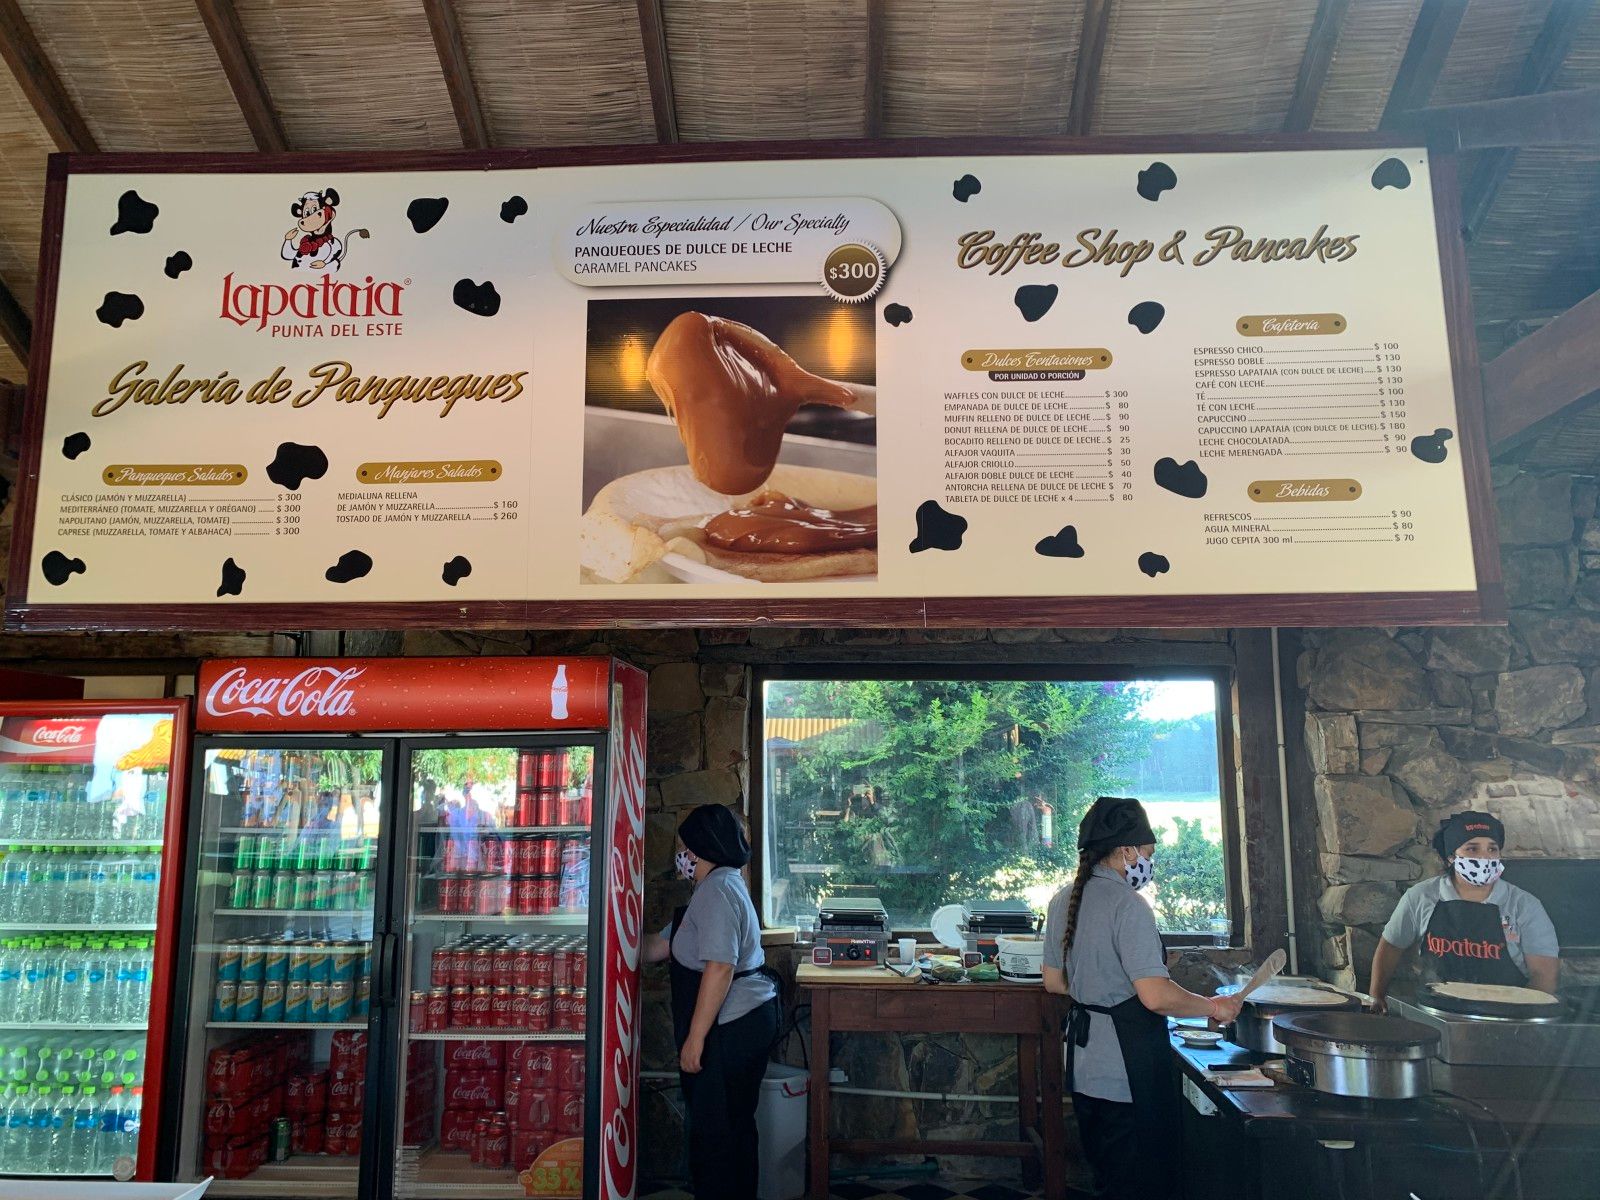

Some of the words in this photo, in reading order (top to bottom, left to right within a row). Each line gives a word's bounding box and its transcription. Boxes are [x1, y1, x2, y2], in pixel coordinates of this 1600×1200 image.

[577, 216, 639, 237] Nuestra
[642, 214, 731, 239] Especialidad
[733, 215, 744, 232] /
[751, 213, 784, 232] Our
[784, 212, 850, 236] Specialty
[575, 244, 661, 258] PANQUEQUES
[665, 243, 682, 255] DE
[686, 242, 727, 255] DULCE
[731, 242, 748, 254] DE
[752, 241, 792, 253] LECHE
[957, 230, 1060, 276] Coffee
[1061, 228, 1155, 278] Shop
[1158, 230, 1187, 264] &
[1193, 224, 1360, 267] Pancakes
[574, 262, 631, 274] CARAMEL
[634, 260, 697, 272] PANCAKES
[829, 262, 877, 280] $300
[1262, 317, 1320, 333] Cafetería
[272, 325, 324, 338] PUNTA
[331, 324, 360, 337] DEL
[366, 323, 403, 336] ESTE
[1193, 347, 1234, 355] ESPRESSO
[982, 353, 1021, 368] Dulces
[1026, 352, 1093, 368] Tentaciones
[1194, 358, 1234, 366] ESPRESSO
[1195, 381, 1215, 389] CAFÉ
[1239, 380, 1265, 388] LECHE
[91, 360, 243, 418] Galería
[245, 366, 292, 404] de
[292, 360, 529, 419] Panqueques
[944, 392, 978, 400] WAFFLES
[1028, 391, 1038, 399] DE
[944, 403, 988, 411] EMPANADA
[1196, 403, 1205, 411] TÉ
[1208, 403, 1226, 411] CON
[1229, 403, 1255, 411] LECHE
[1197, 415, 1246, 423] CAPUCCINO
[1198, 438, 1224, 446] LECHE
[1227, 437, 1289, 445] CHOCOLATADA
[944, 449, 978, 457] ALFAJOR
[980, 449, 1015, 457] VAQUITA
[1228, 449, 1283, 457] MERENGADA
[115, 467, 186, 486] Panqueques
[187, 467, 233, 482] Salados
[375, 465, 435, 483] Manjares
[436, 464, 483, 479] Salados
[945, 472, 978, 480] ALFAJOR
[1009, 471, 1034, 479] DULCE
[1036, 471, 1046, 479] DE
[1049, 471, 1074, 479] LECHE
[1275, 482, 1330, 498] Bebidas
[61, 494, 92, 502] CLÁSICO
[94, 494, 125, 502] (JAMÓN
[127, 494, 132, 502] Y
[134, 494, 186, 502] MUZZARELLA)
[338, 492, 382, 500] MEDIALUNA
[945, 495, 978, 503] TABLETA
[1033, 494, 1058, 502] LECHE
[60, 505, 118, 513] MEDITERRÁNEO
[120, 505, 155, 513] (TOMATE,
[157, 505, 206, 513] MUZZARELLA
[209, 505, 213, 513] Y
[216, 505, 256, 513] ORÉGANO)
[349, 503, 376, 511] JAMÓN
[378, 503, 383, 511] Y
[385, 503, 435, 511] MUZZARELLA
[502, 501, 518, 509] 160
[385, 514, 411, 522] JAMÓN
[501, 512, 518, 520] 260
[1204, 513, 1252, 521] REFRESCOS
[58, 528, 90, 536] CAPRESE
[92, 528, 146, 536] (MUZZARELLA,
[149, 527, 179, 535] TOMATE
[181, 527, 186, 535] Y
[188, 527, 231, 535] ALBAHACA)
[1204, 525, 1229, 533] AGUA
[1232, 524, 1271, 532] MINERAL
[1402, 522, 1413, 530] 80
[1205, 537, 1228, 545] JUGO
[1263, 536, 1279, 544] 300
[1282, 536, 1293, 544] ml
[205, 666, 367, 717] Coca-Cola
[32, 726, 86, 744] Coca-Cola
[604, 690, 647, 1200] Coca-Cola
